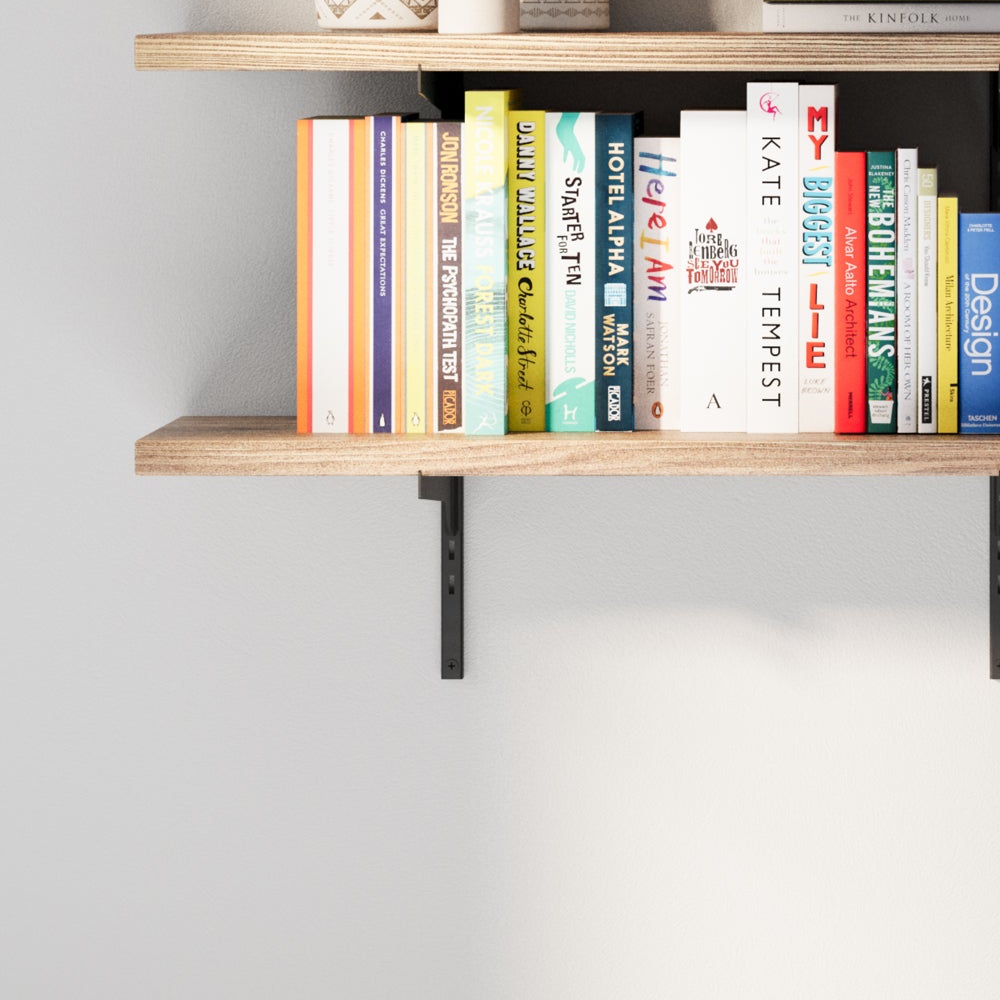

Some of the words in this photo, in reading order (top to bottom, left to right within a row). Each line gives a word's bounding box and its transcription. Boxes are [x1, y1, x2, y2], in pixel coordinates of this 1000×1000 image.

[843, 14, 861, 22] THE
[868, 13, 940, 24] KINFOLK
[946, 14, 971, 22] HOME
[440, 132, 459, 163] JON
[474, 105, 495, 175] NICOLE
[516, 121, 536, 182] DANNY
[807, 106, 829, 160] MY
[608, 142, 625, 205] HOTEL
[638, 151, 678, 230] Here
[761, 136, 781, 206] KATE
[903, 159, 912, 182] Chris
[439, 164, 459, 223] RONSON
[561, 177, 585, 242] STARTER
[868, 185, 881, 209] NEW
[882, 188, 895, 209] THE
[474, 180, 495, 258] KRAUSS
[516, 186, 536, 271] WALLACE
[695, 228, 722, 246] TORE
[803, 176, 834, 267] BIGGEST
[903, 215, 911, 252] Madden
[441, 236, 457, 262] THE
[556, 235, 568, 254] FOR
[608, 209, 625, 276] ALPHA
[640, 229, 670, 253] I
[844, 226, 857, 259] Alvar
[561, 252, 582, 285] TEN
[643, 255, 675, 302] Am
[686, 265, 739, 284] TOMORROW
[844, 261, 857, 296] Aalto
[867, 212, 895, 358] BOHEMIANS
[903, 281, 911, 291] A
[944, 274, 955, 298] Milan
[964, 273, 970, 281] of
[441, 265, 458, 349] PSYCHOPATH
[474, 264, 495, 337] FOREST
[517, 277, 535, 344] Charlotte
[564, 289, 577, 321] DAVID
[903, 292, 911, 328] ROOM
[603, 313, 616, 377] WATSON
[616, 323, 630, 366] MARK
[646, 312, 656, 360] SAFRAN
[806, 283, 827, 368] LIE
[844, 298, 858, 359] Architect
[903, 329, 911, 347] OF
[944, 299, 954, 352] Architecture
[963, 272, 999, 376] Design
[442, 350, 458, 383] TEST
[517, 345, 537, 391] Street
[564, 322, 577, 374] NICHOLLS
[657, 321, 670, 388] JONATHAN
[761, 287, 781, 407] TEMPEST
[903, 347, 911, 370] HER
[474, 342, 495, 396] DARK
[646, 363, 656, 394] FOER
[903, 372, 911, 401] OWN
[442, 389, 457, 425] PICADOR
[608, 385, 621, 421] PICADOR
[706, 393, 722, 409] A
[968, 414, 998, 422] TASCHEN
